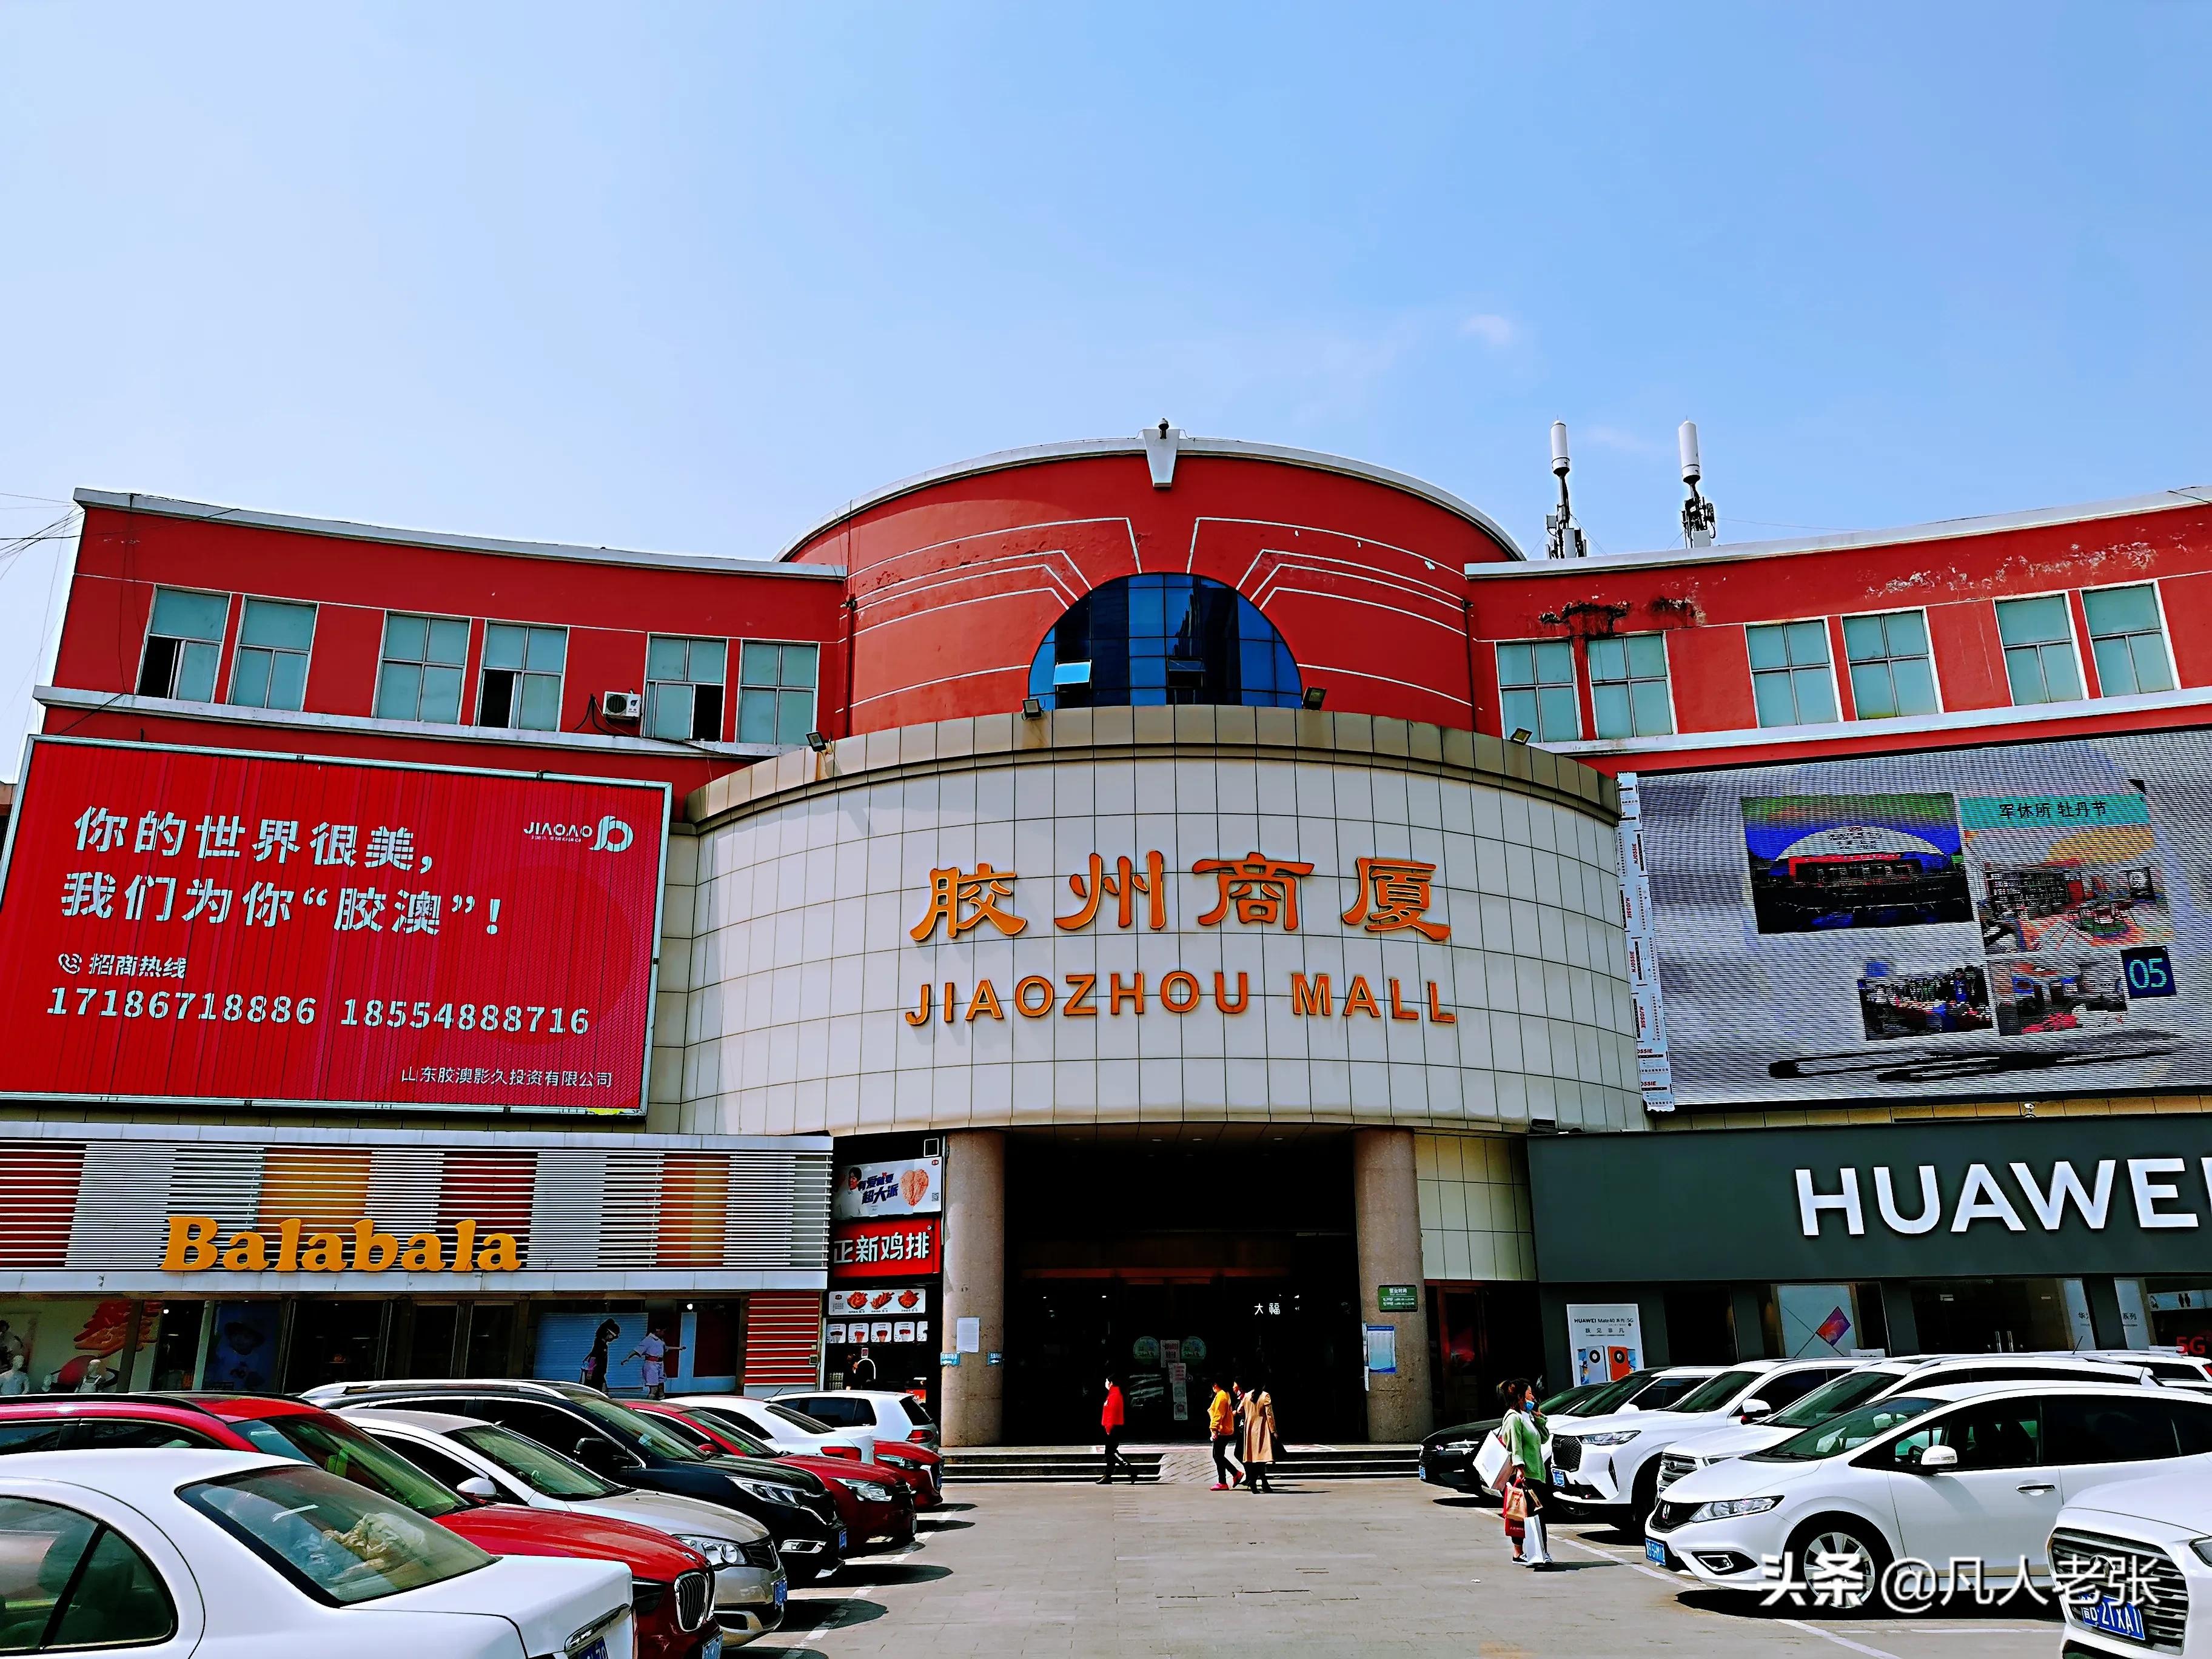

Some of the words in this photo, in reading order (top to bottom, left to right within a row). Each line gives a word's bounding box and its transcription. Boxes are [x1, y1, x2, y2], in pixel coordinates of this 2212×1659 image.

[910, 850, 1452, 942] 胶州商厦
[88, 954, 187, 979] 招商热线
[2129, 958, 2168, 990] 05
[47, 987, 317, 1025] 17186718886
[340, 999, 589, 1034] 18554888716
[905, 970, 1249, 1026] JIAOZHOU
[1292, 973, 1456, 1023] MALL
[401, 1066, 612, 1088] 山东胶澳影久投资有限公司
[1795, 1157, 2212, 1236] HUAWE
[160, 1216, 522, 1272] Balabala
[834, 1232, 930, 1264] 正新鸡排
[1254, 1302, 1281, 1315] 大福
[2176, 1336, 2206, 1355] 5G
